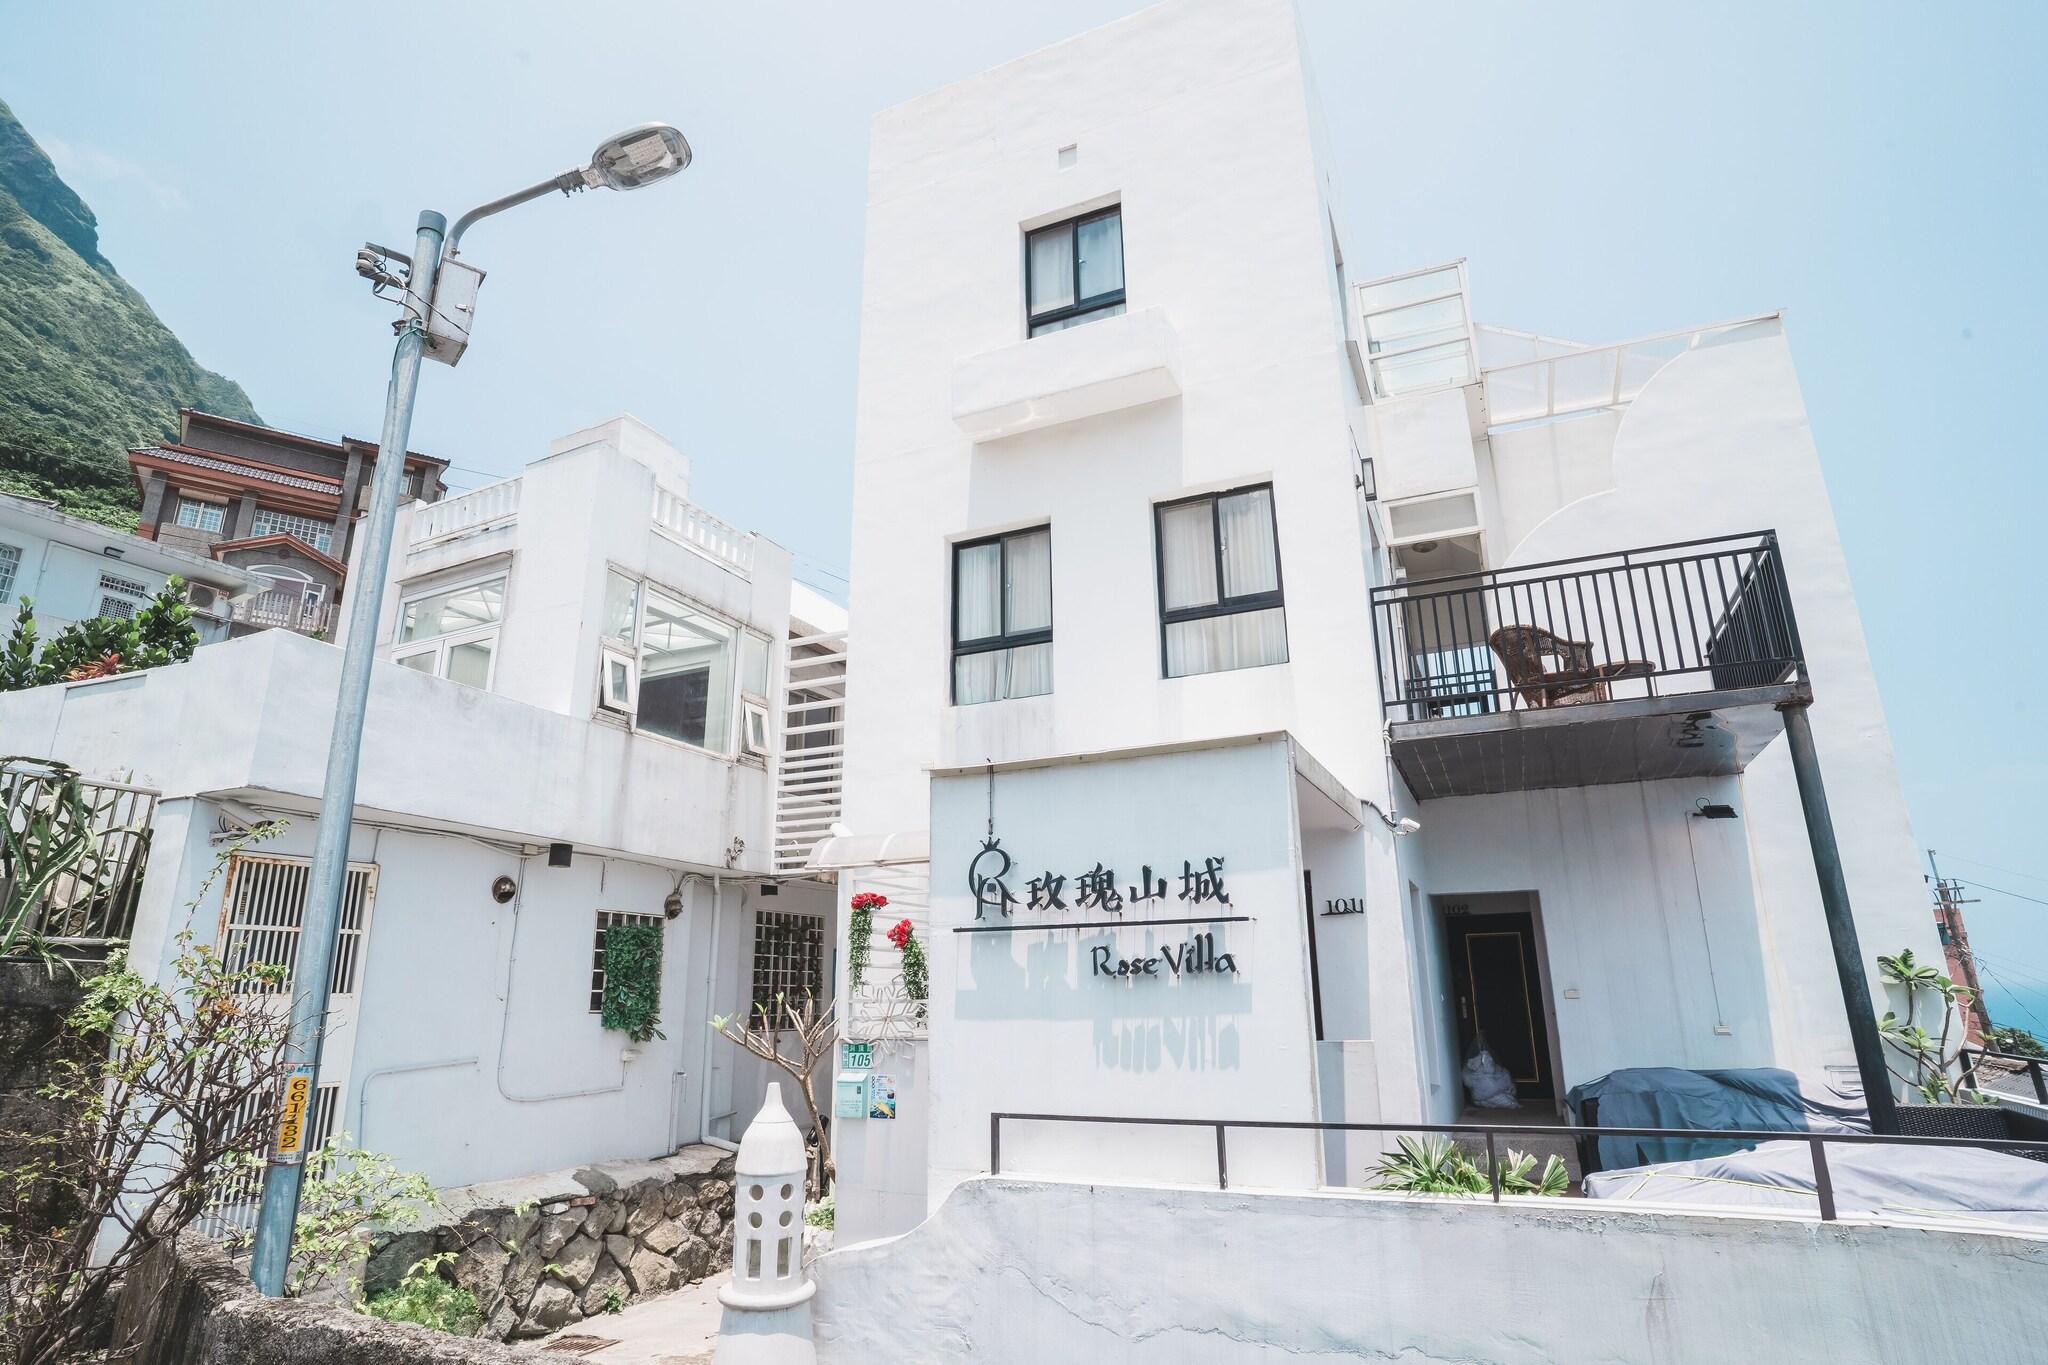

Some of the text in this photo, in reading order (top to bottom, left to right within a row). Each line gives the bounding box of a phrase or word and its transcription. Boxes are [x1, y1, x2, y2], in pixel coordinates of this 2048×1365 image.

[1025, 856, 1230, 913] 玫瑰山城
[851, 1054, 871, 1067] 105
